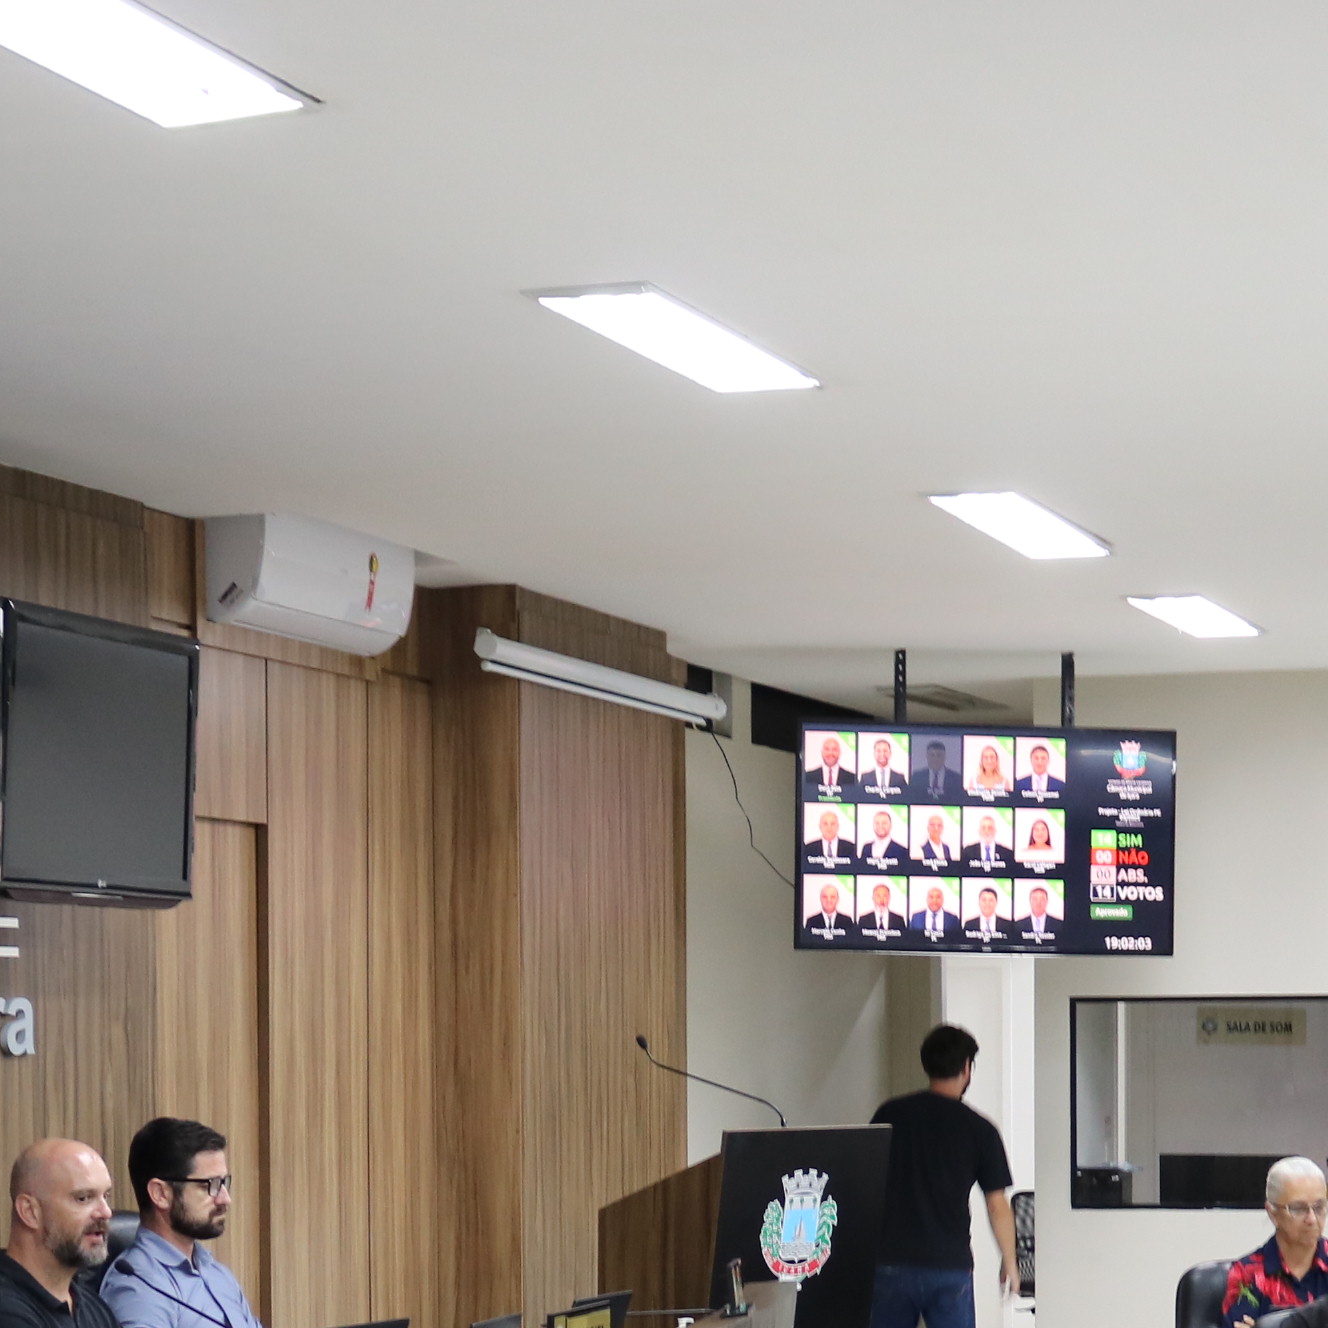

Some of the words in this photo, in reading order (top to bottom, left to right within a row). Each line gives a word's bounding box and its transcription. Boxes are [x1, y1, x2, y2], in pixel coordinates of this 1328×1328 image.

[1118, 833, 1142, 847] SIM
[1095, 850, 1112, 864] 00
[1119, 848, 1149, 865] NÃO
[1097, 868, 1110, 879] 00
[1096, 886, 1111, 899] 14
[1118, 886, 1163, 901] VOTOS
[1227, 1021, 1251, 1033] SALA
[1254, 1022, 1266, 1033] DE
[1270, 1022, 1292, 1033] SOM
